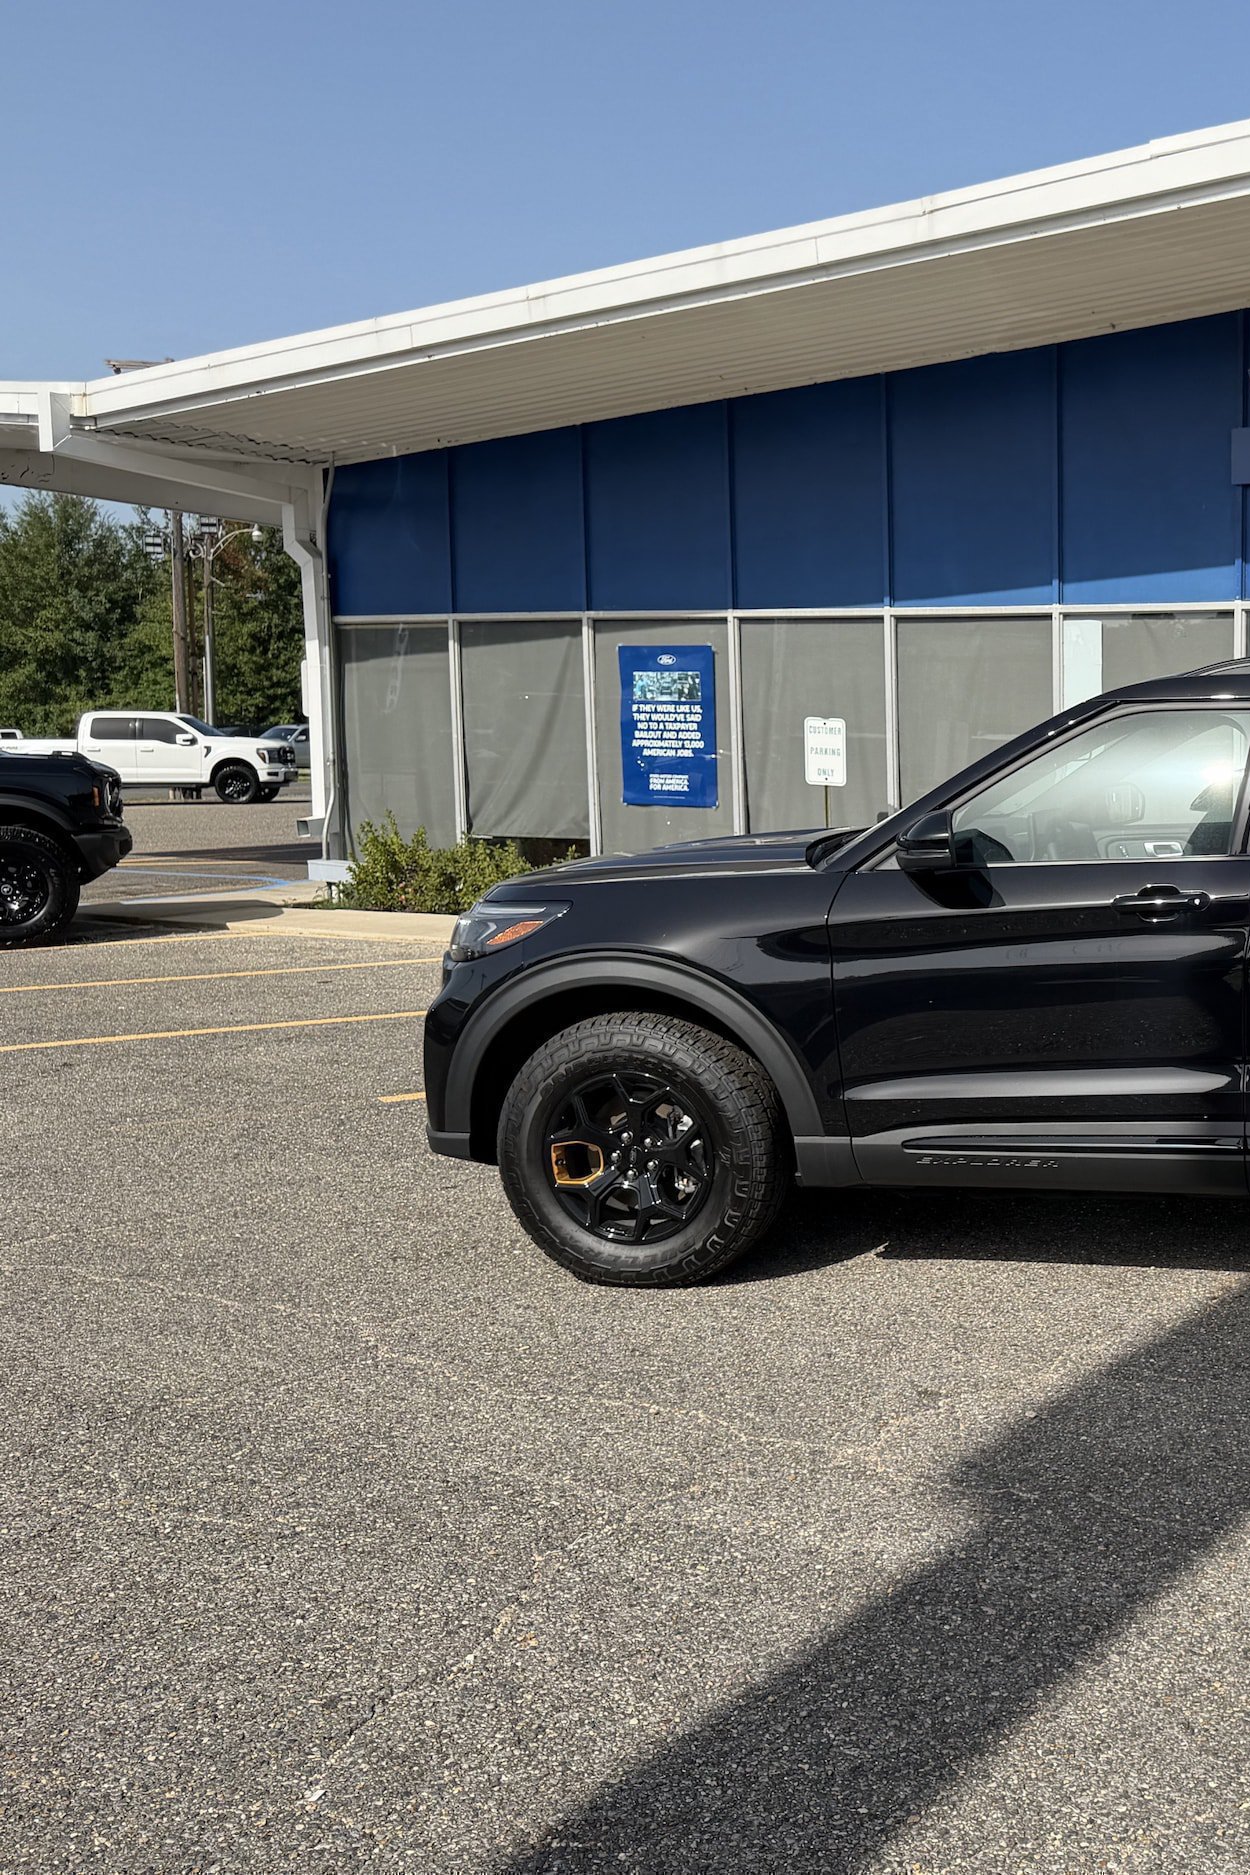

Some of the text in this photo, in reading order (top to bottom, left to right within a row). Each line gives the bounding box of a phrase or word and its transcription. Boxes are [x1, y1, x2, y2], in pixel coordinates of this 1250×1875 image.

[632, 704, 639, 712] IF
[639, 704, 656, 712] THEY
[691, 705, 703, 713] US,
[633, 713, 702, 722] THEY WOULD'VE SAID
[637, 722, 698, 730] NO TO A TAXPAYER
[809, 725, 842, 735] CUSTOMER
[634, 730, 661, 738] BAILOUT
[678, 731, 701, 739] ADDED
[632, 739, 682, 748] APPROXIMATELY
[642, 748, 695, 757] AMERICAN JOBS.
[810, 747, 841, 756] PARKING
[817, 768, 834, 777] ONLY
[649, 783, 661, 791] FOR
